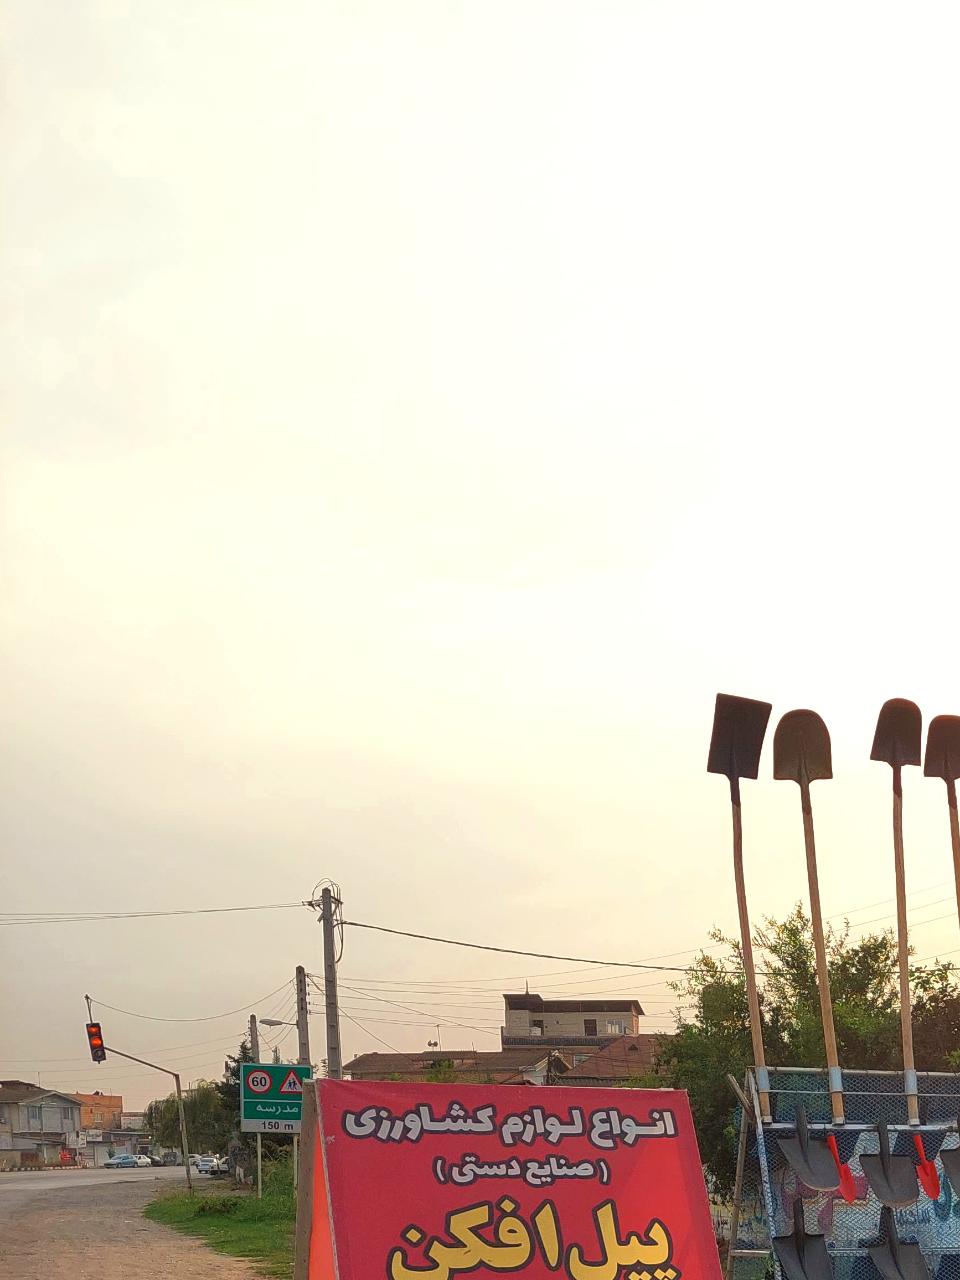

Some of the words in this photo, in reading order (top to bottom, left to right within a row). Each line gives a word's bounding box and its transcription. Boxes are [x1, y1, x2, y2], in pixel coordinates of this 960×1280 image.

[251, 1076, 267, 1087] 60
[256, 1104, 299, 1116] مدرسه
[344, 1103, 494, 1141] کشاورزی
[262, 1121, 280, 1130] 150
[284, 1123, 294, 1131] m
[501, 1108, 583, 1144] لوازم
[590, 1110, 675, 1148] انواع
